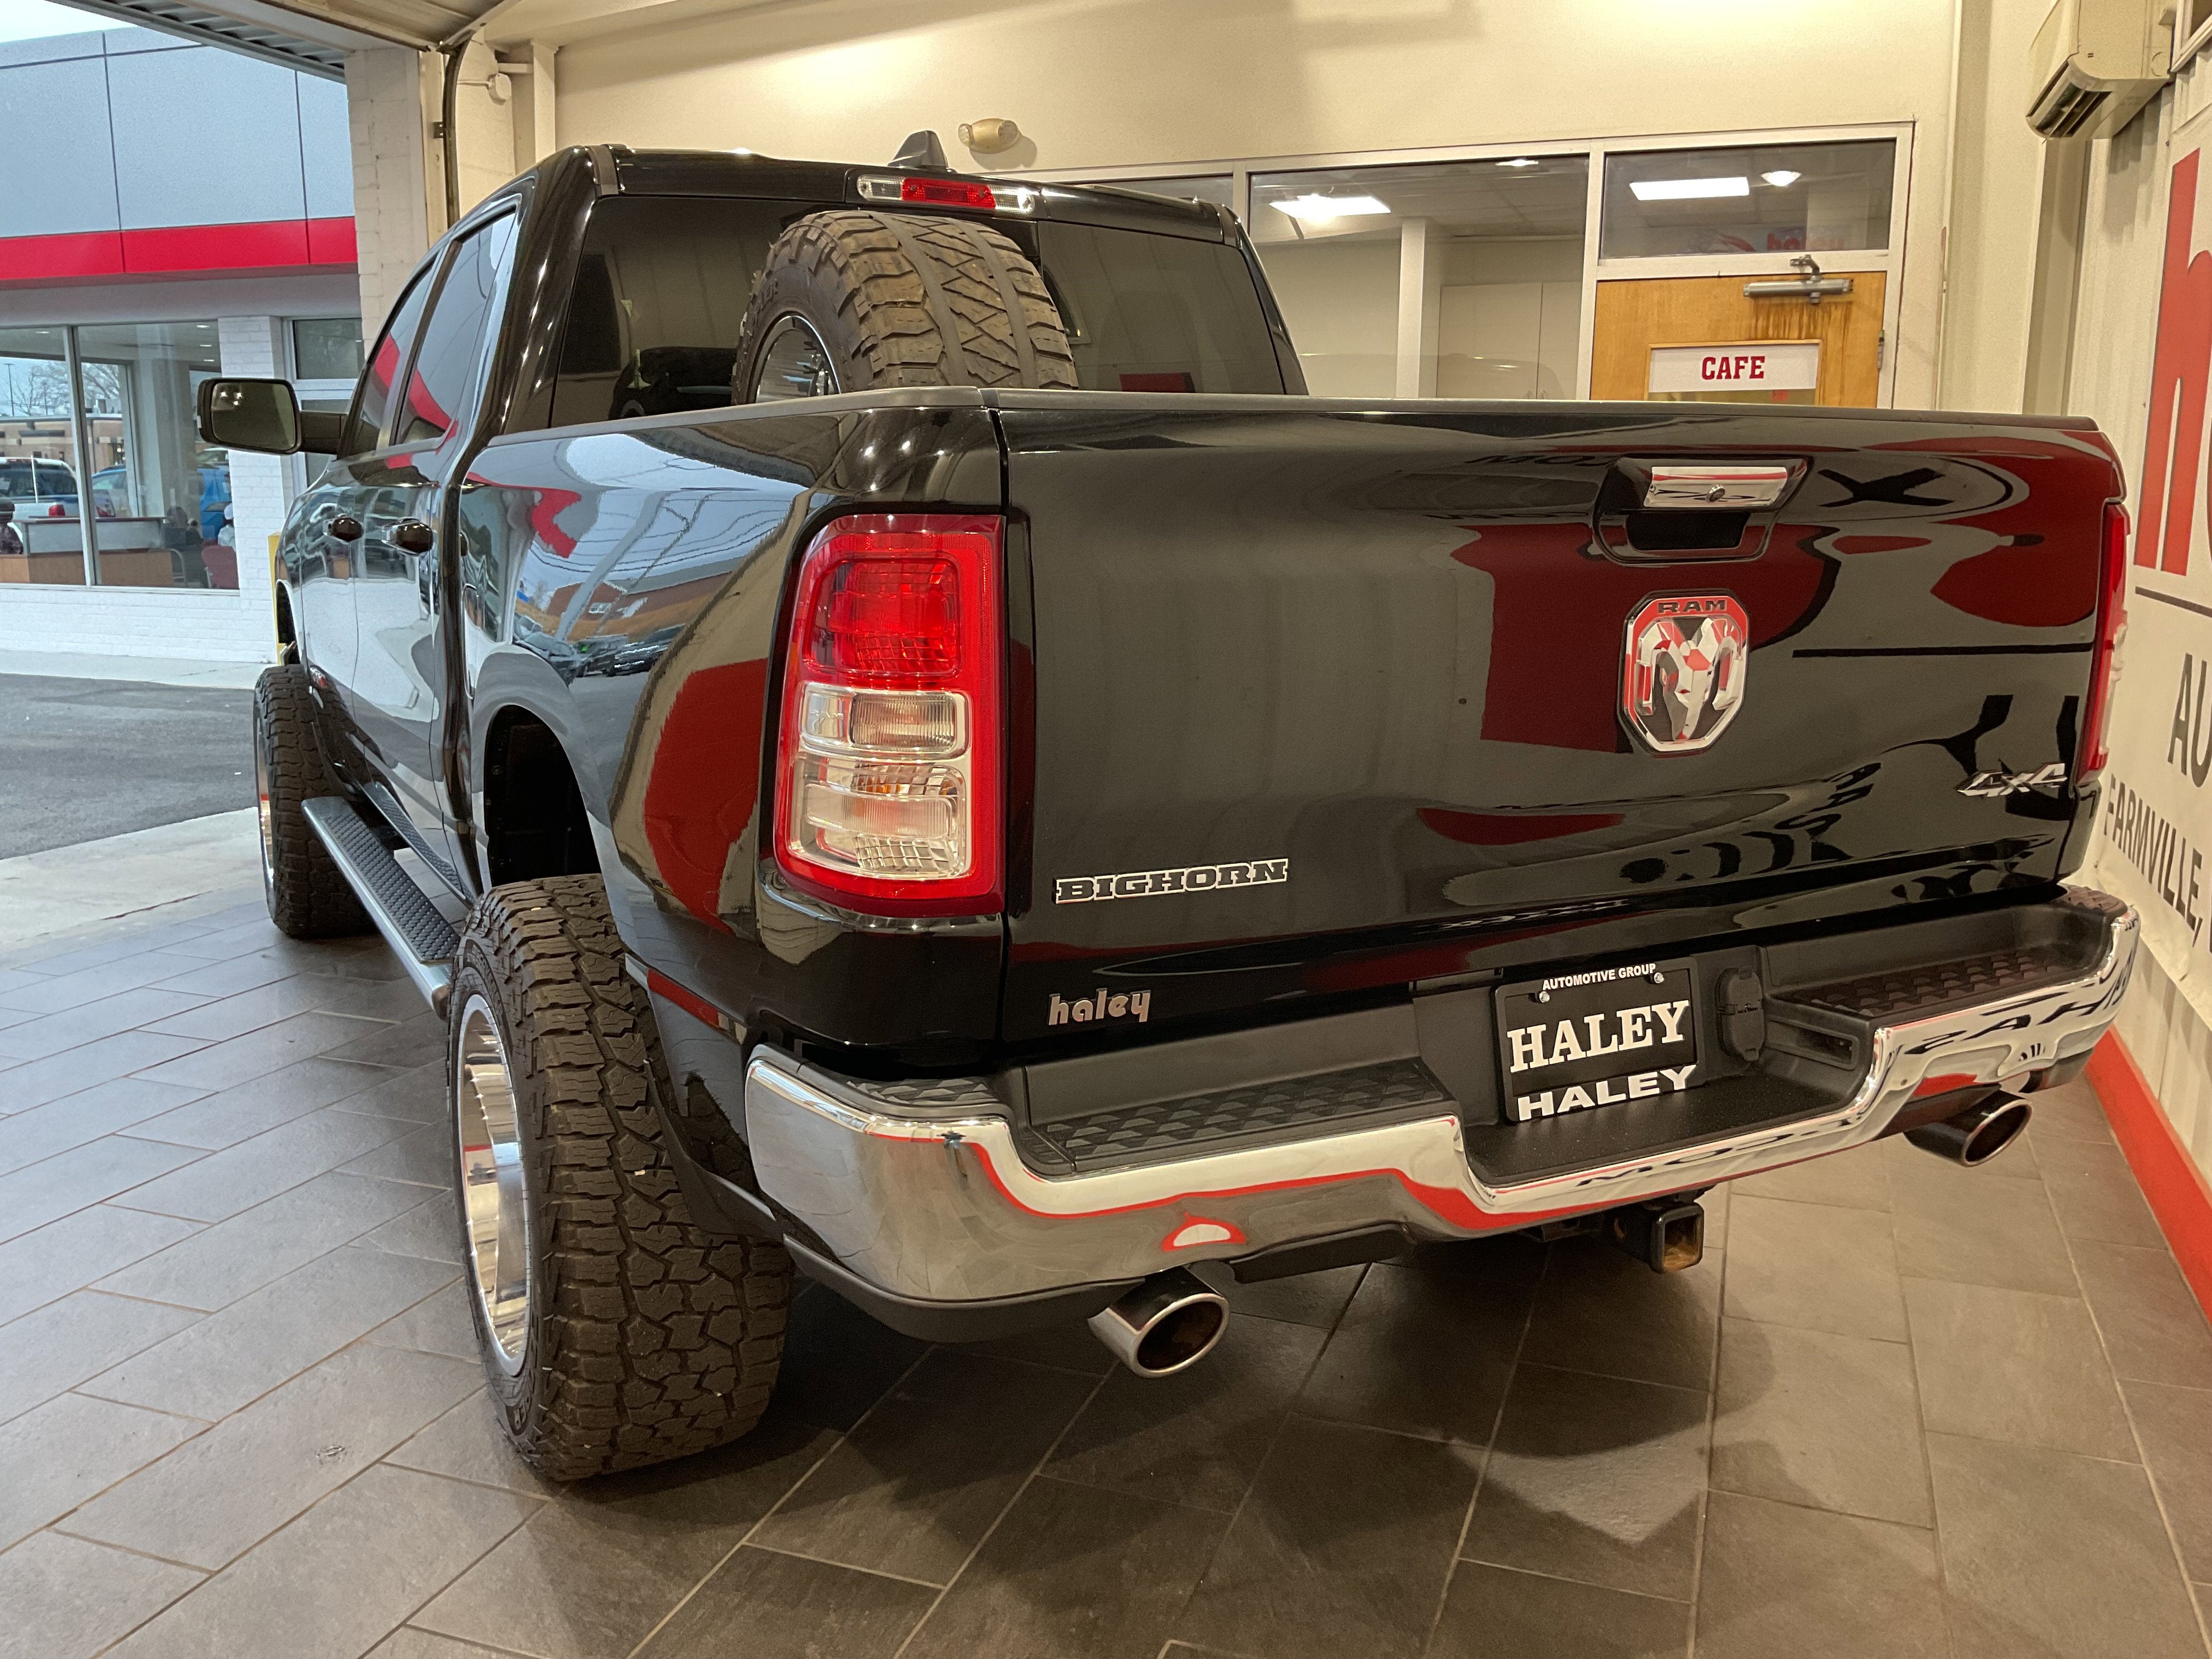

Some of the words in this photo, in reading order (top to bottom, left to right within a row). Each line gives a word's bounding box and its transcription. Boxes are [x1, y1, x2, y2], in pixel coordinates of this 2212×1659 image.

[1701, 356, 1765, 380] CAFE
[1658, 600, 1727, 614] RAM
[1054, 858, 1288, 904] BIGHORN
[2104, 774, 2203, 948] FARMVILLE,
[1542, 969, 1616, 991] AUTOMOTIVE
[1618, 963, 1656, 979] GROUP
[1048, 988, 1151, 1026] haley
[1506, 1000, 1689, 1073] HALEY
[1517, 1064, 1697, 1121] HALEY
